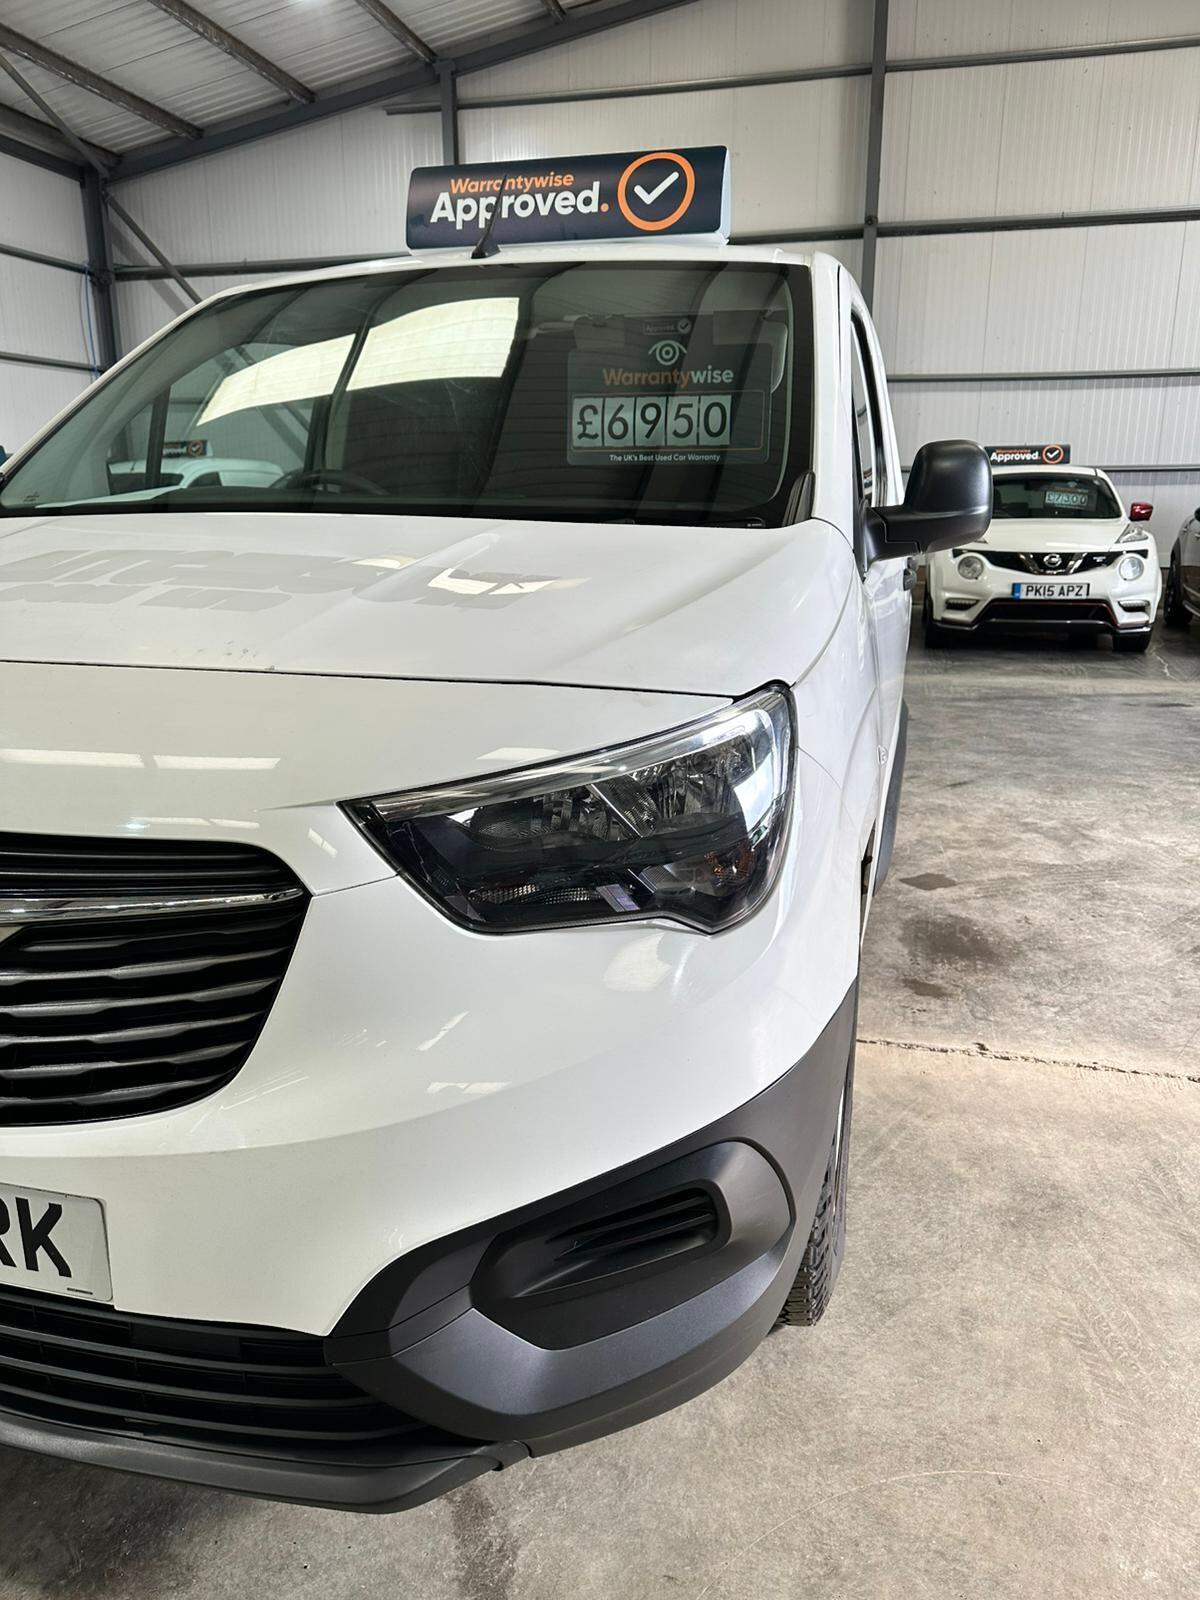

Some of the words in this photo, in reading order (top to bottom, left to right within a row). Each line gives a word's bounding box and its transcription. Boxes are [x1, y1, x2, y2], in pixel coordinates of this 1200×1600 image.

[450, 171, 575, 194] Warrantywise
[602, 365, 735, 388] Warrantywise
[576, 401, 729, 441] £6950
[609, 454, 622, 462] The
[623, 454, 638, 462] UK's
[639, 454, 654, 462] Best
[655, 454, 672, 462] Used
[673, 454, 687, 462] Car
[688, 453, 721, 463] Warranty
[1025, 584, 1056, 597] PK15
[1058, 585, 1084, 597] APZ
